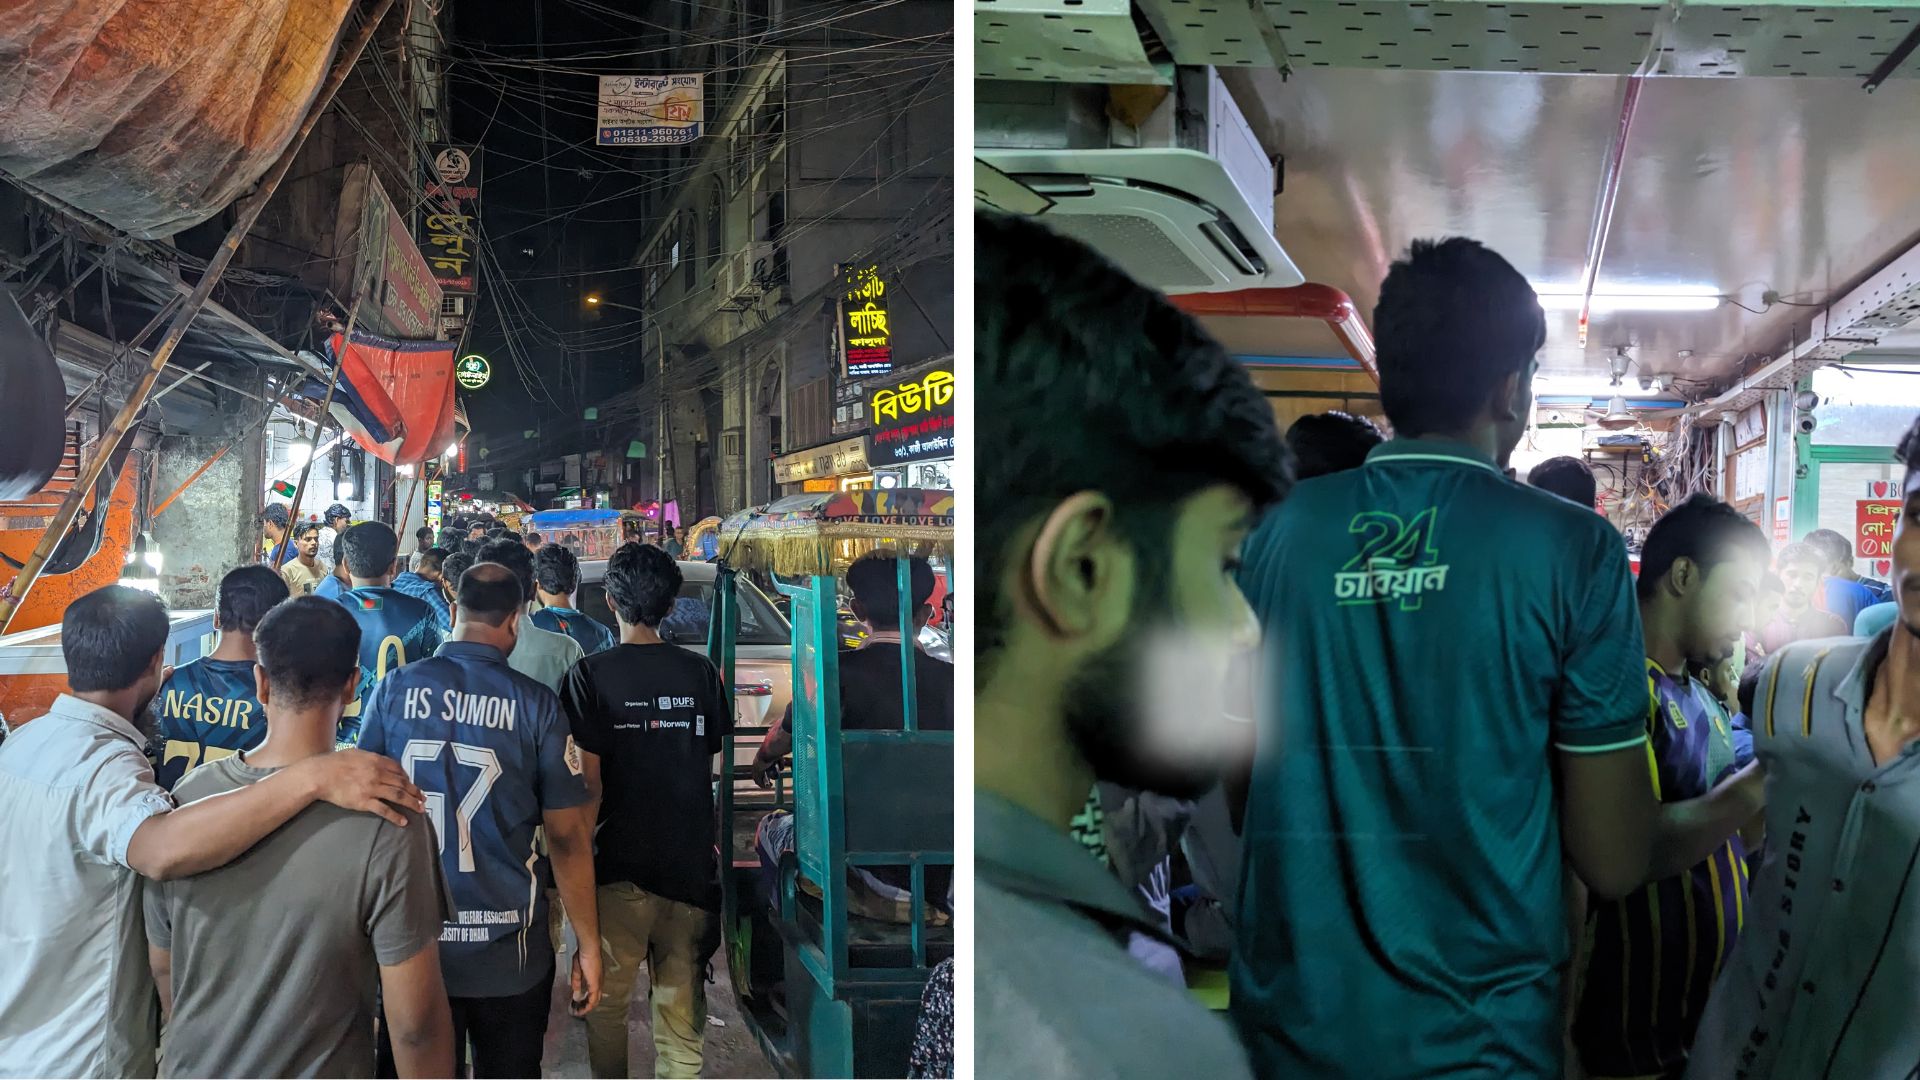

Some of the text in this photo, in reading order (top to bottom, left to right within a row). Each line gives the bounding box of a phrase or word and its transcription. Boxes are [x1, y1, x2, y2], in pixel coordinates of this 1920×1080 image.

[671, 76, 697, 87] সংযোগ
[848, 302, 890, 335] লাচ্ছি
[870, 371, 955, 425] বিউটি
[902, 516, 934, 526] LOVE
[1342, 506, 1439, 611] 24
[1334, 557, 1450, 599] ঢাবিয়ান
[163, 689, 253, 730] NASIR
[403, 687, 517, 731] HS SUMON
[673, 697, 695, 706] DUFS
[659, 720, 690, 729] Norway
[1780, 806, 1811, 916] STORY
[457, 910, 483, 925] WELFARE
[461, 927, 469, 942] OF
[469, 927, 490, 942] DHAKA
